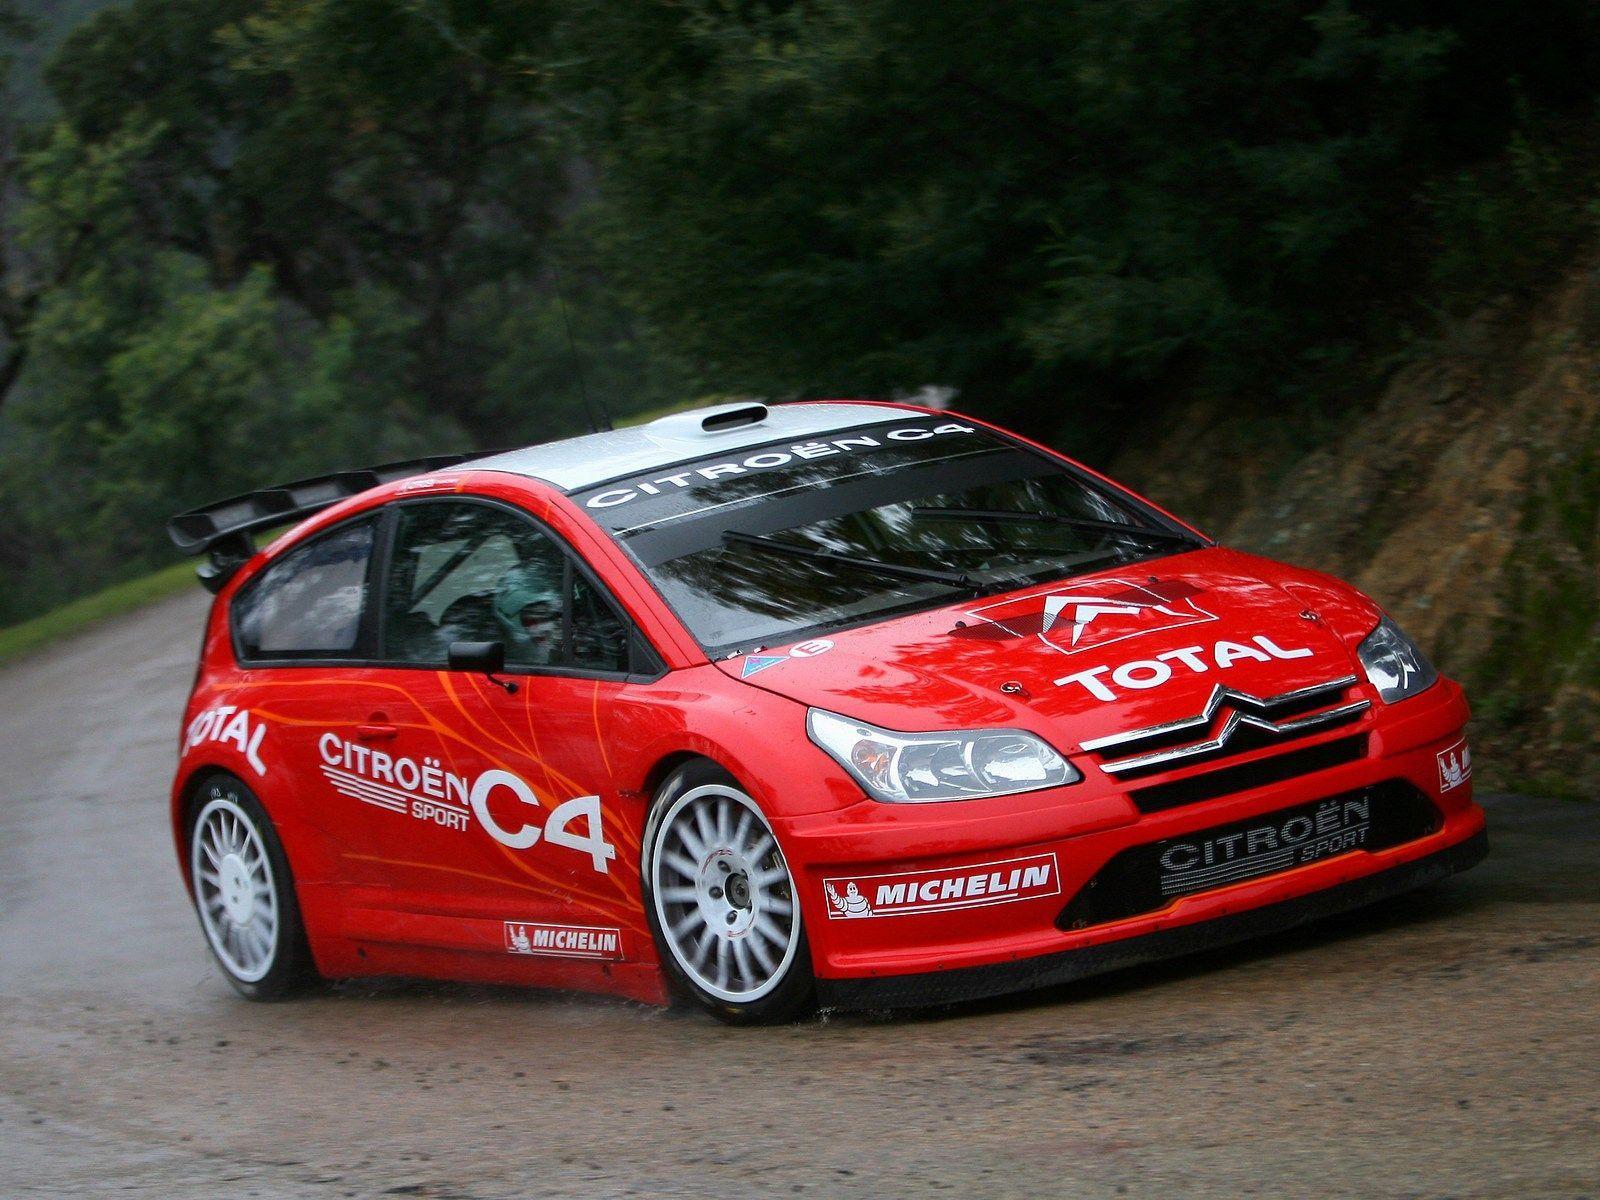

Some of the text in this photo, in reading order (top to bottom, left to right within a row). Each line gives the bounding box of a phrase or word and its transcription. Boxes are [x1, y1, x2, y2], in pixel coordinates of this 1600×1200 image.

[586, 422, 976, 509] CITROËN C4
[1052, 635, 1315, 702] TOTAL
[318, 732, 616, 875] CITROËN C4
[411, 800, 470, 832] SPORT
[1160, 796, 1370, 872] CITROËN
[1300, 825, 1370, 863] SPORT
[875, 864, 1051, 906] MICHELIN
[532, 929, 617, 952] MICHELIN
